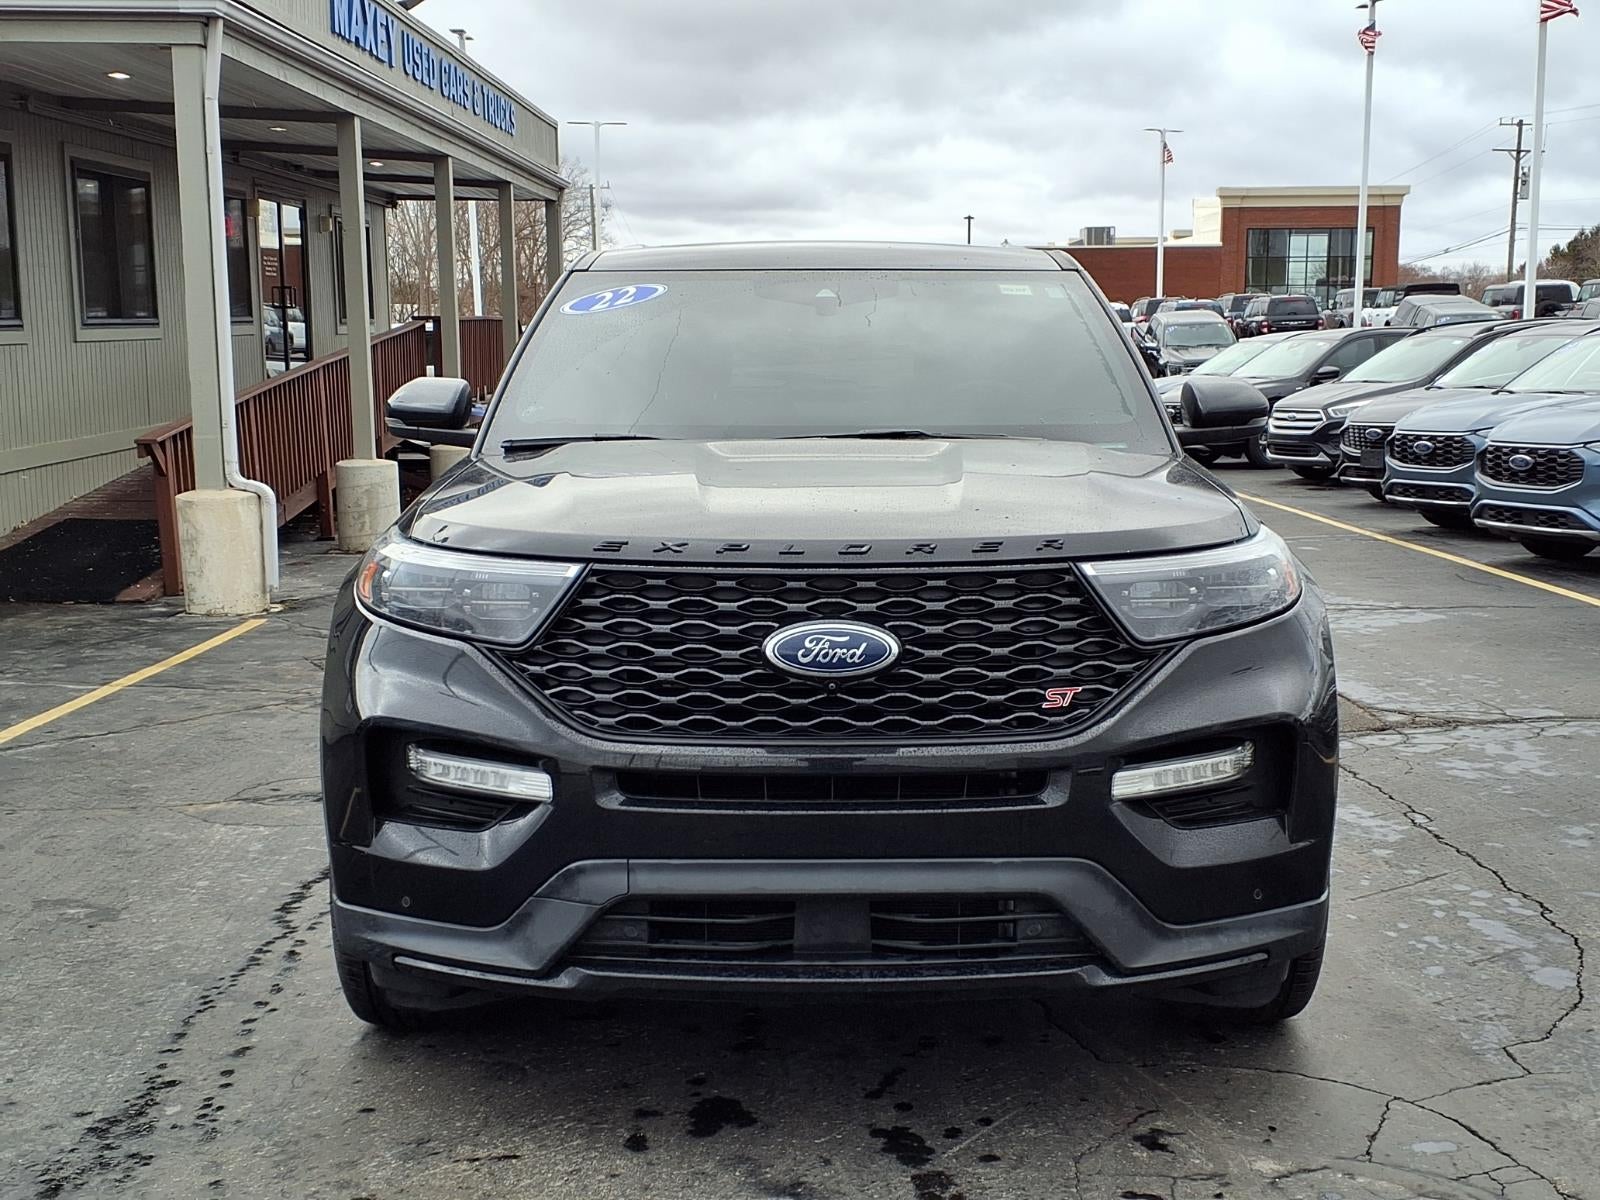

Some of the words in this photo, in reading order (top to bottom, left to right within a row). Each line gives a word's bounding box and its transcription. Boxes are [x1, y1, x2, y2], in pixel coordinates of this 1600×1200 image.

[330, 0, 397, 68] MAXEY
[401, 30, 438, 91] USED
[440, 57, 470, 110] CARS
[472, 79, 481, 116] &
[482, 88, 517, 136] TRUCKS
[588, 286, 637, 311] 22
[593, 538, 1065, 556] EXPLORER
[797, 634, 868, 664] Ford
[1042, 686, 1083, 709] ST
